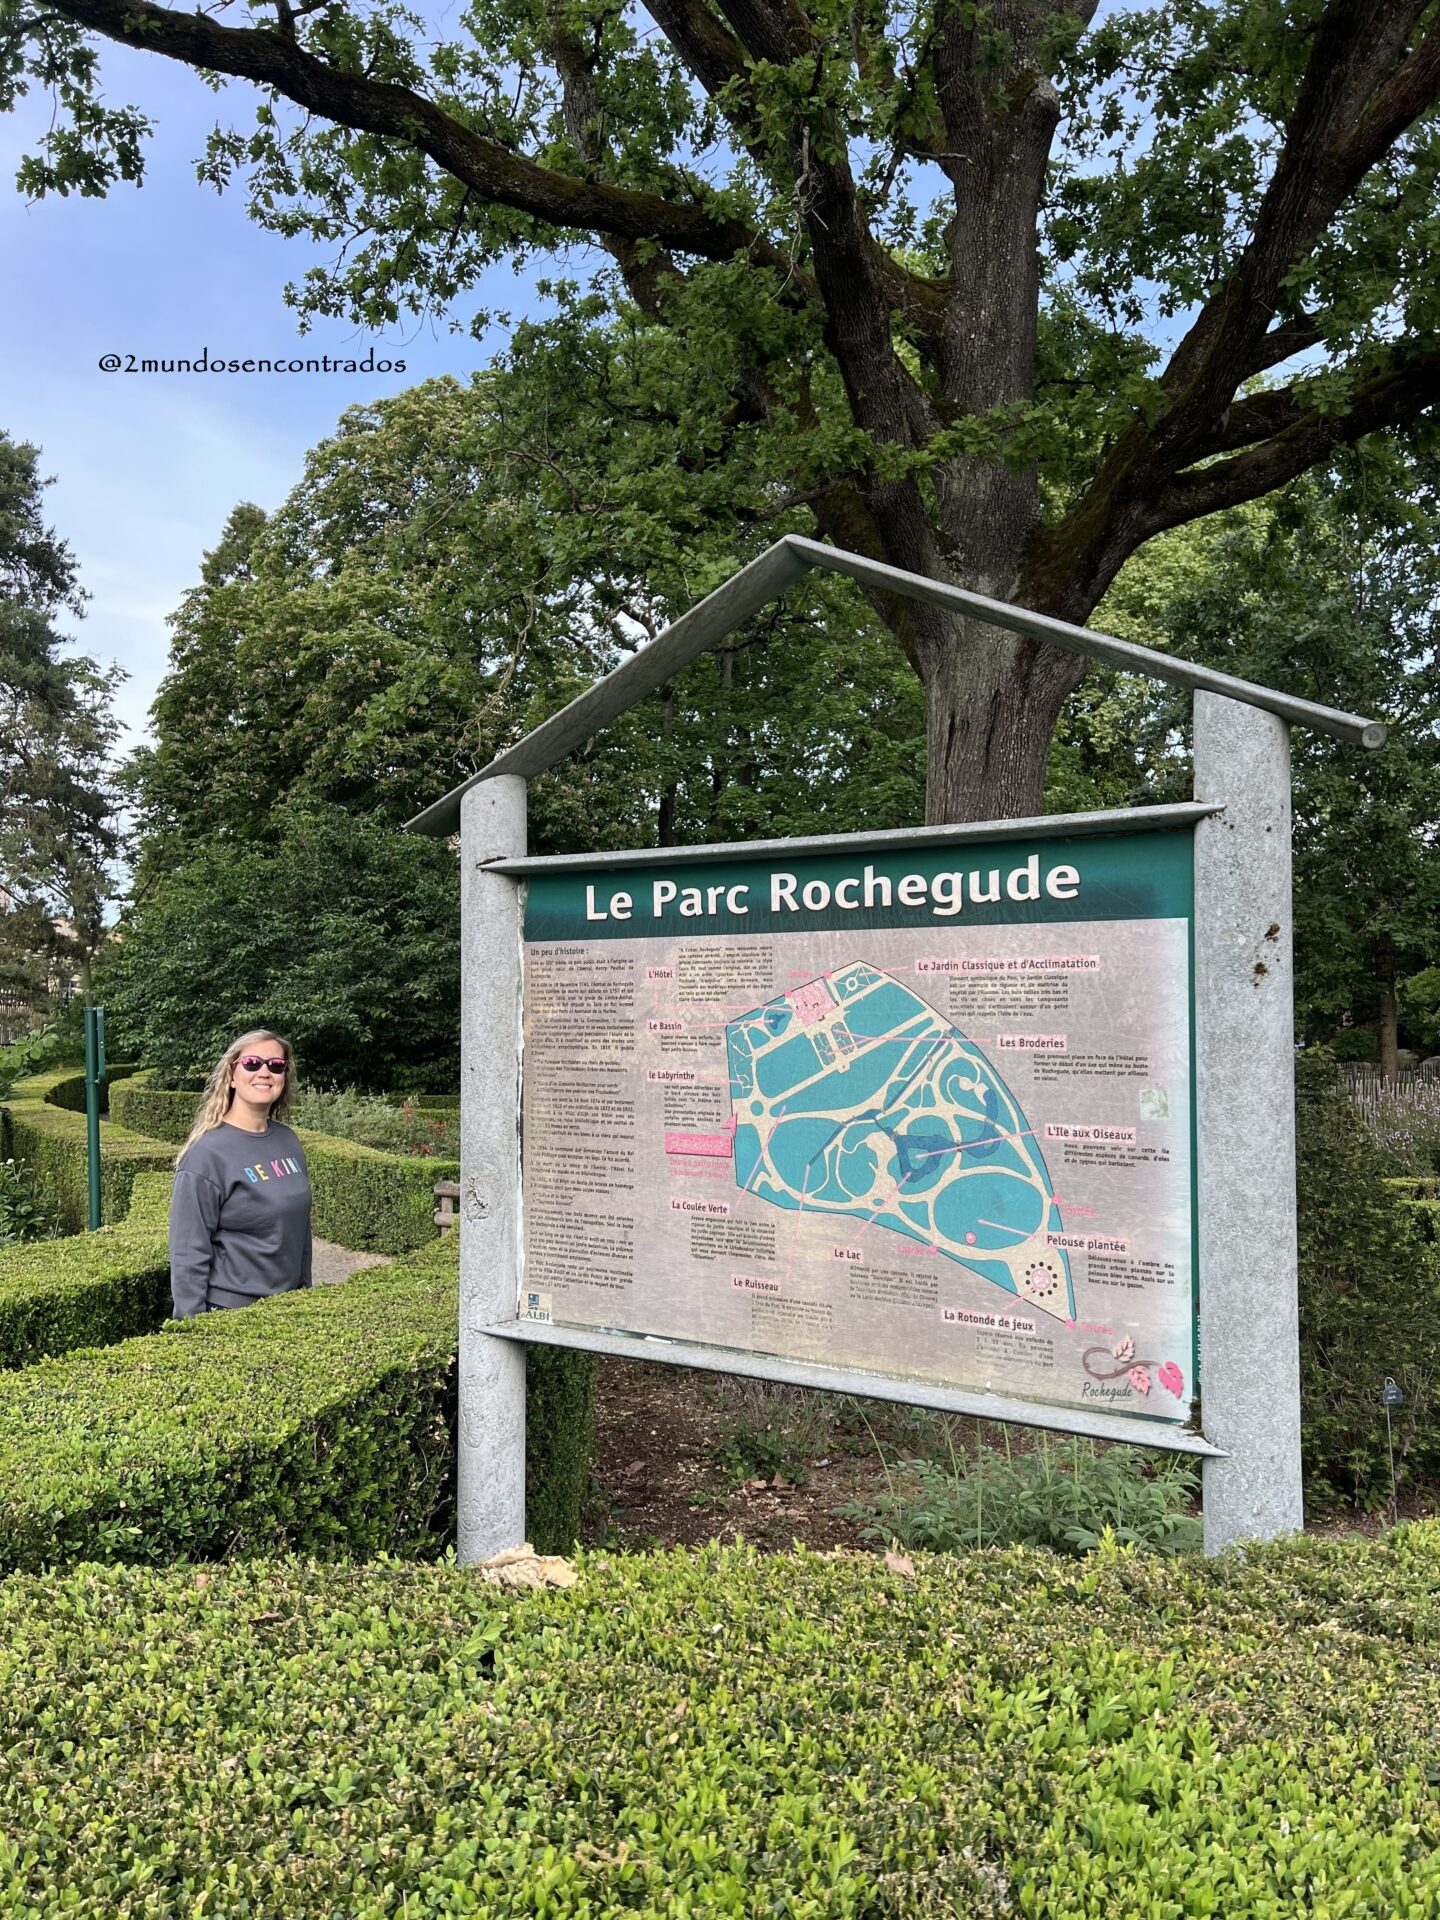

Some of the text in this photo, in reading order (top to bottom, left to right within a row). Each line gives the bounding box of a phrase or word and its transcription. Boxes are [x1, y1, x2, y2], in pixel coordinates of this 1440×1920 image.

[585, 854, 1081, 920] Le Parc Rochegude
[542, 949, 552, 958] peu
[554, 946, 584, 956] d'histoire
[918, 959, 1096, 971] Le Jardin Classique et d'Acclimatation
[648, 970, 673, 979] L'Hôtel
[649, 1022, 682, 1030] Le Bassin
[1000, 1037, 1064, 1048] Les Broderies
[649, 1071, 695, 1081] le Labyrinthe
[1048, 1126, 1133, 1140] L'Ile aux Oiseaux
[243, 1163, 270, 1183] BE
[672, 1200, 727, 1214] La Coulée Verte
[1047, 1235, 1126, 1252] Pelouse plantée
[834, 1249, 861, 1260] Le Lac
[734, 1278, 779, 1292] Le Ruisseau
[944, 1310, 1034, 1331] La Rotonde de jeux
